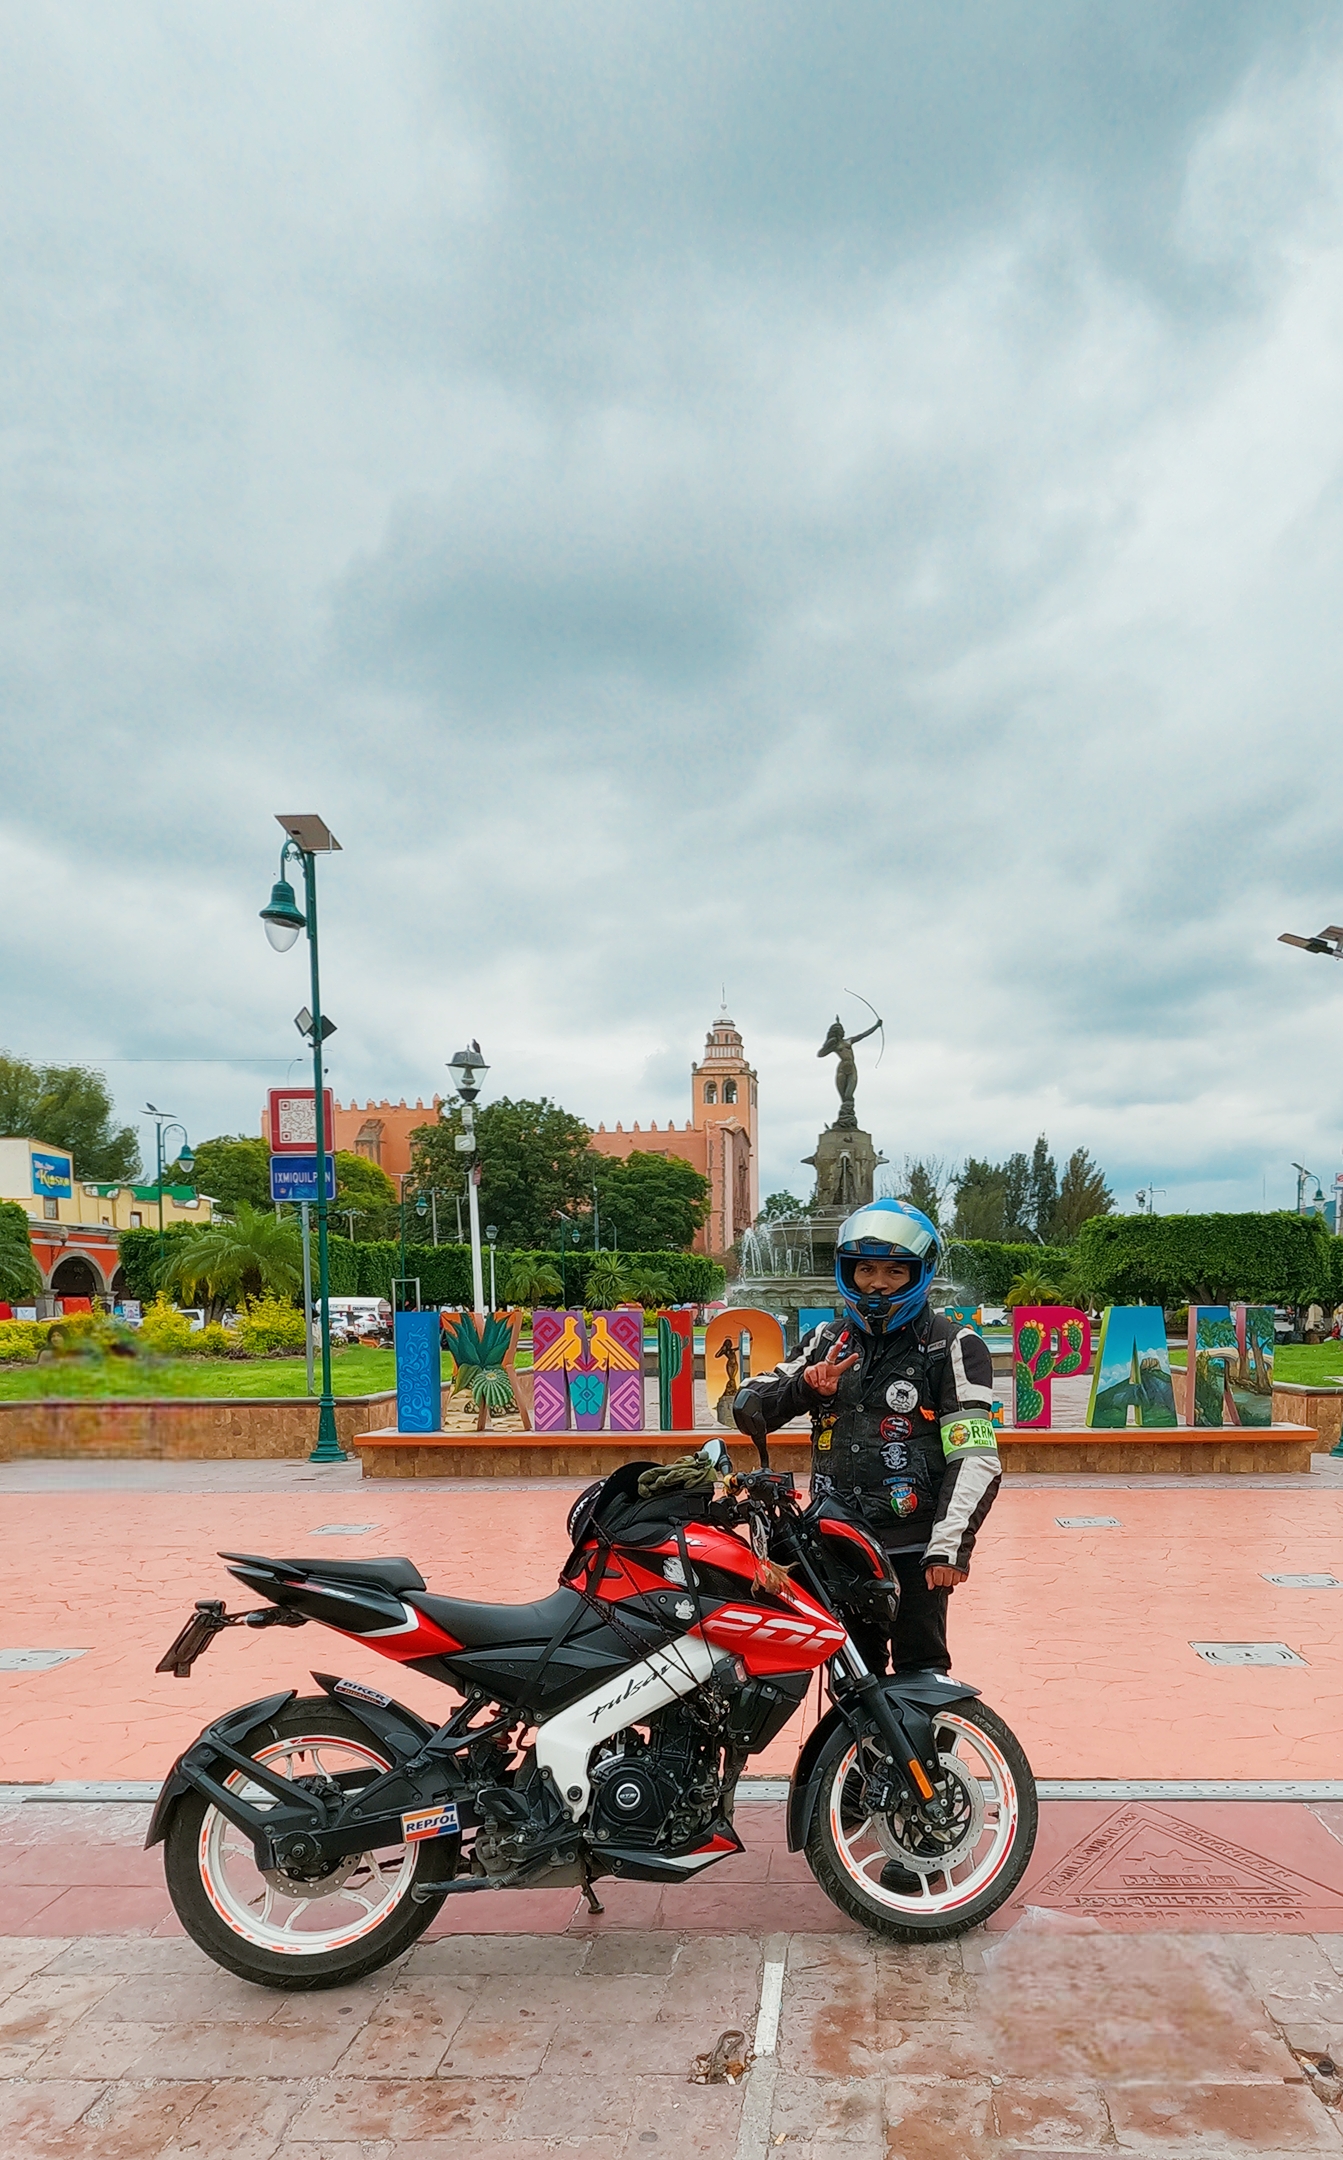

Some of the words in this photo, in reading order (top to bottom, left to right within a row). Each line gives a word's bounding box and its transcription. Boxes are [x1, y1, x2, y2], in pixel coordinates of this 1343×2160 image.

[274, 1172, 331, 1184] IXMIQUILPN
[343, 1682, 386, 1702] BIKER
[406, 1813, 456, 1832] REPSOL
